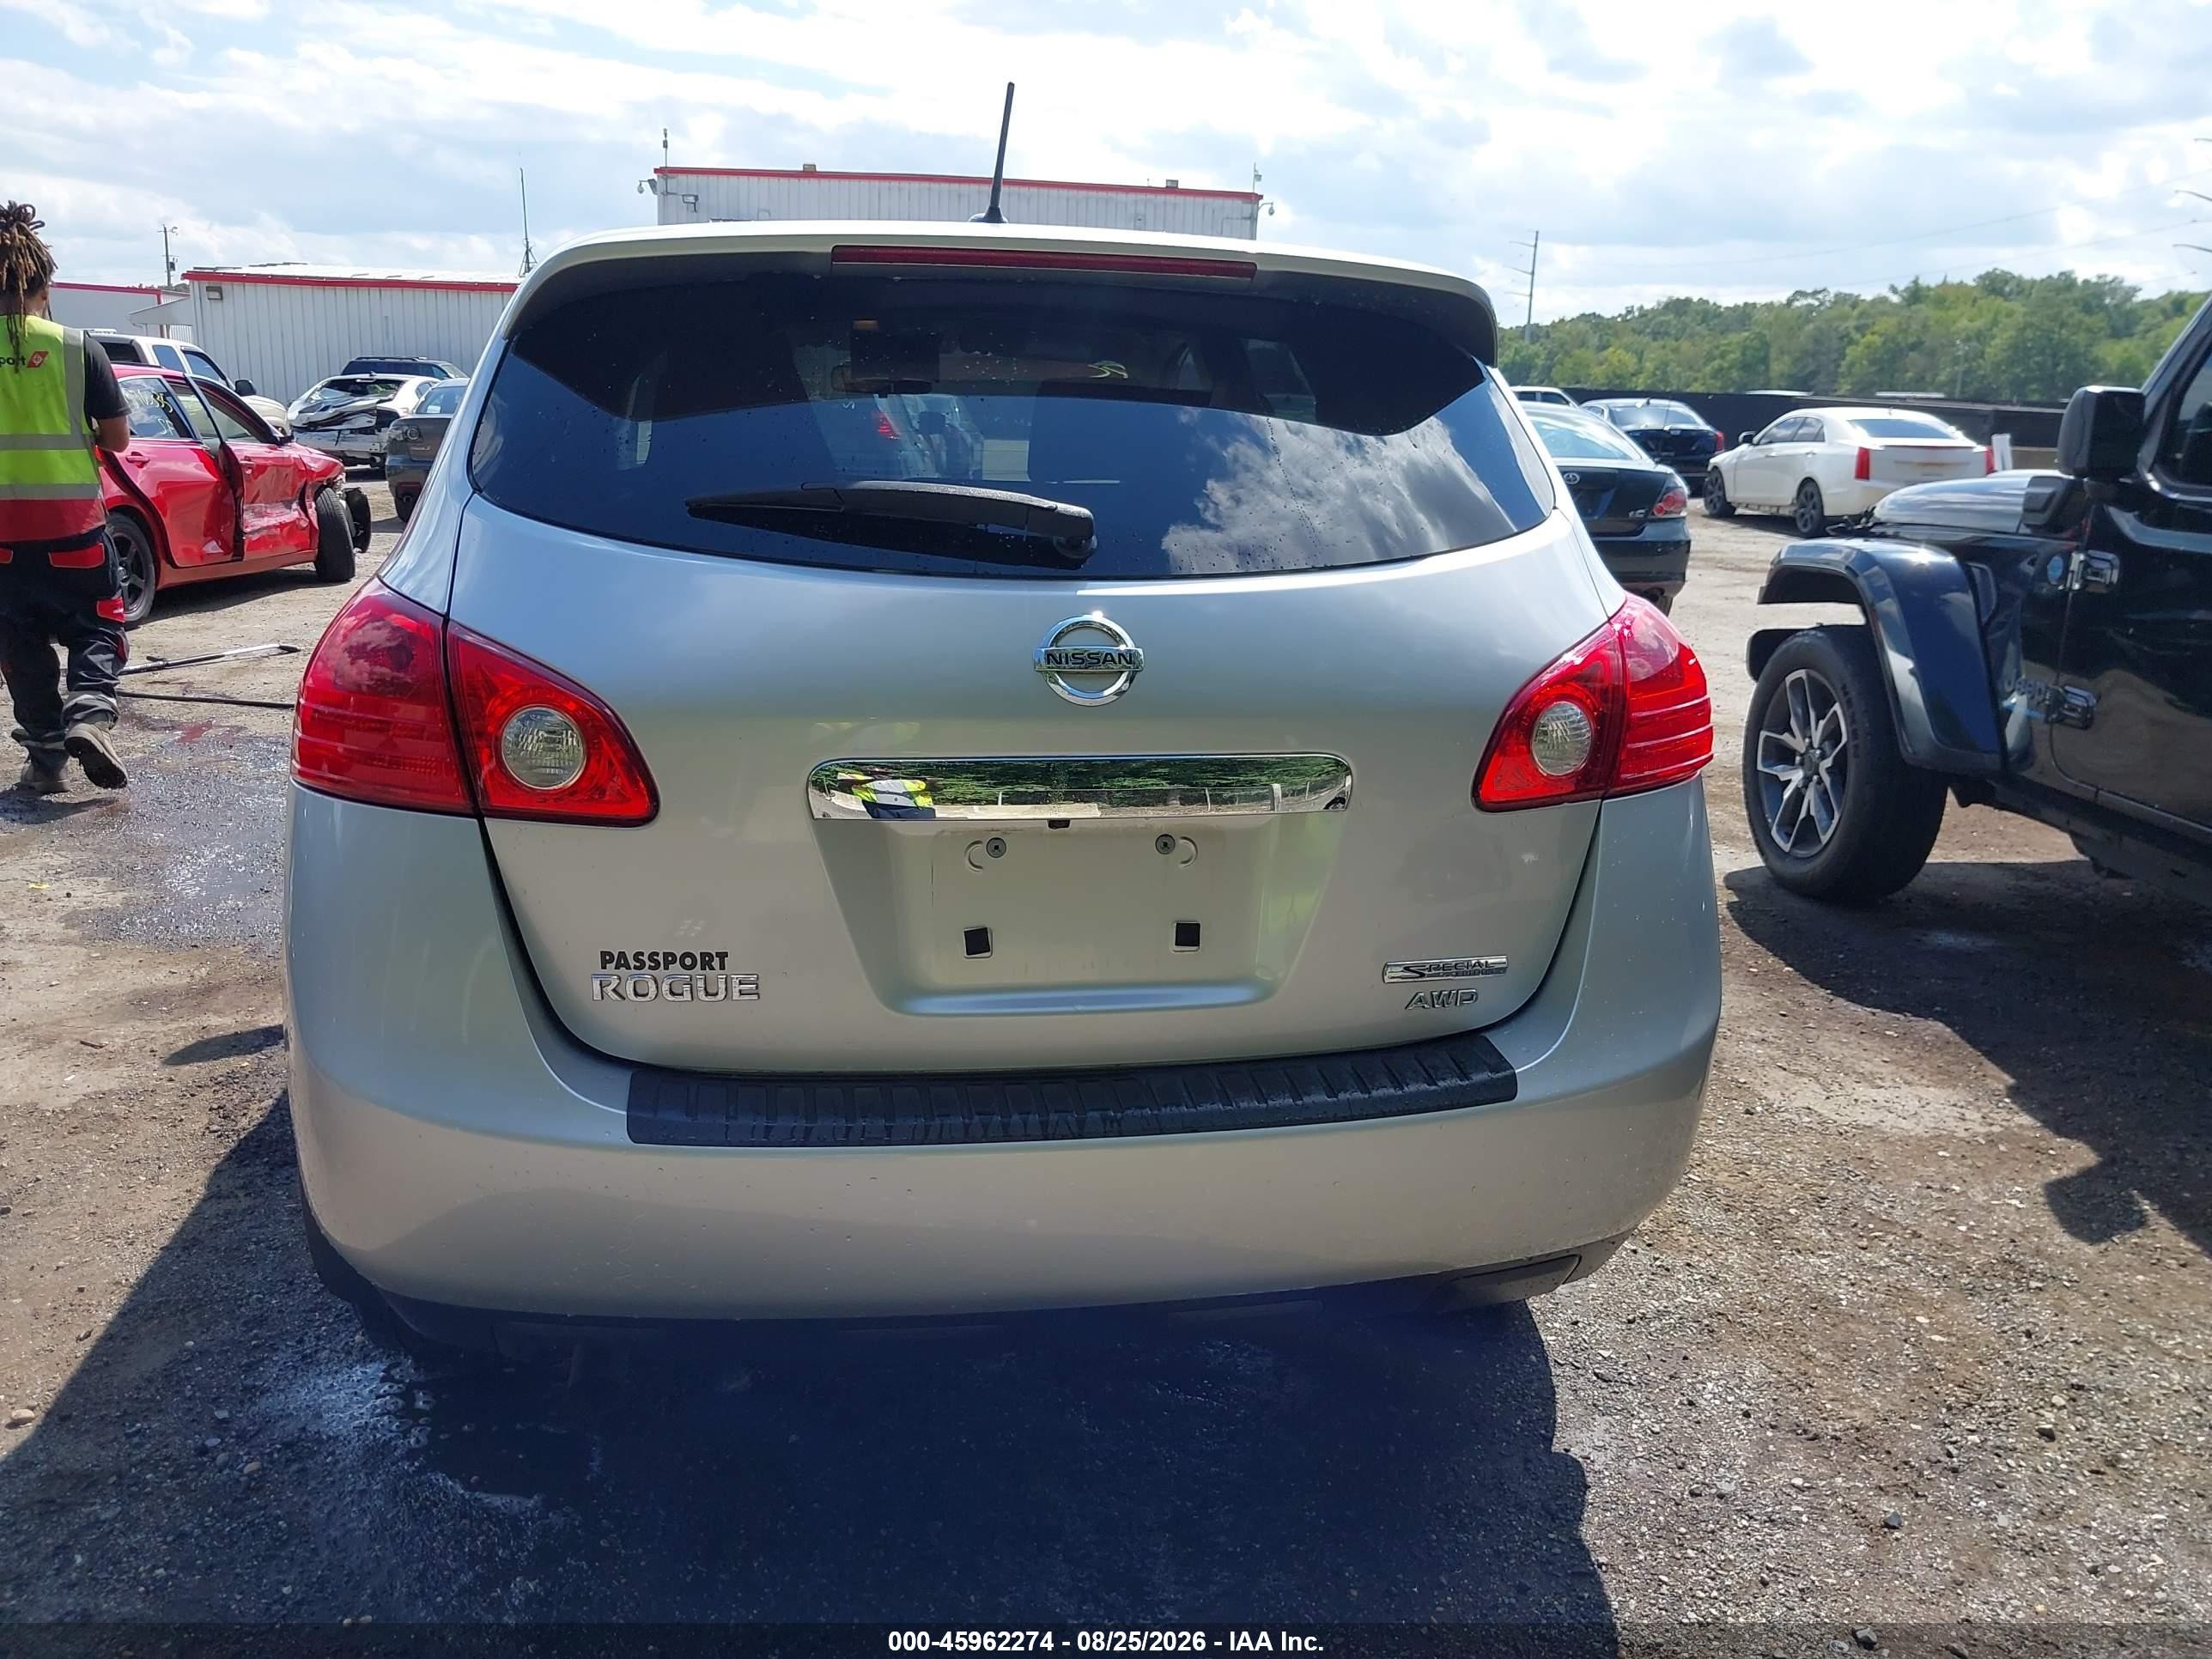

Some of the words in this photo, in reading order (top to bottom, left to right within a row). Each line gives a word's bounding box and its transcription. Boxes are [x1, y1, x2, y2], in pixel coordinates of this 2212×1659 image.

[1046, 652, 1133, 665] NISSAN
[600, 951, 729, 971] PASSPORT
[1396, 960, 1496, 980] SPECIAL
[591, 974, 760, 1002] ROGUE
[1405, 988, 1479, 1011] AWD
